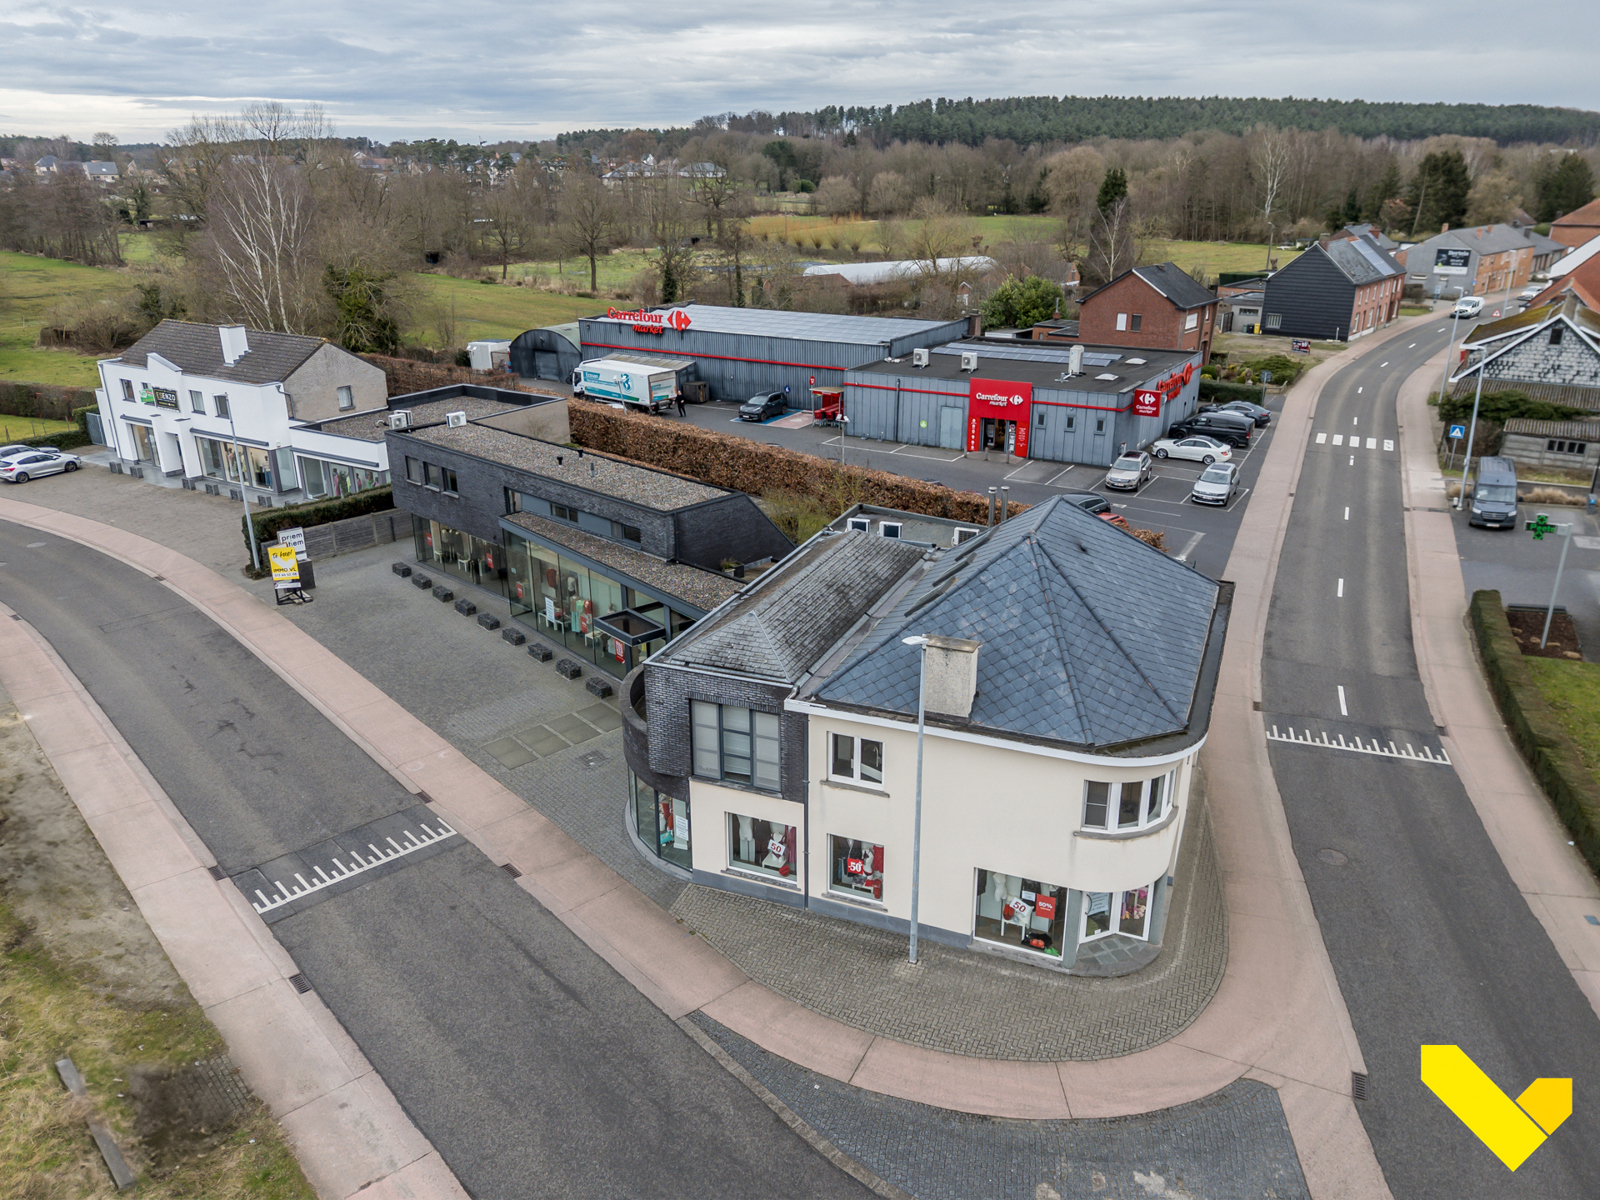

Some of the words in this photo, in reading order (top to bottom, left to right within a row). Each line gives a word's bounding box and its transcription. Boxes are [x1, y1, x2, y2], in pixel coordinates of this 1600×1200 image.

[607, 307, 663, 323] Carrefour
[632, 324, 663, 334] market
[975, 392, 1009, 402] Carrefour
[282, 533, 302, 542] priem
[770, 842, 782, 853] 50
[1012, 901, 1027, 913] 50
